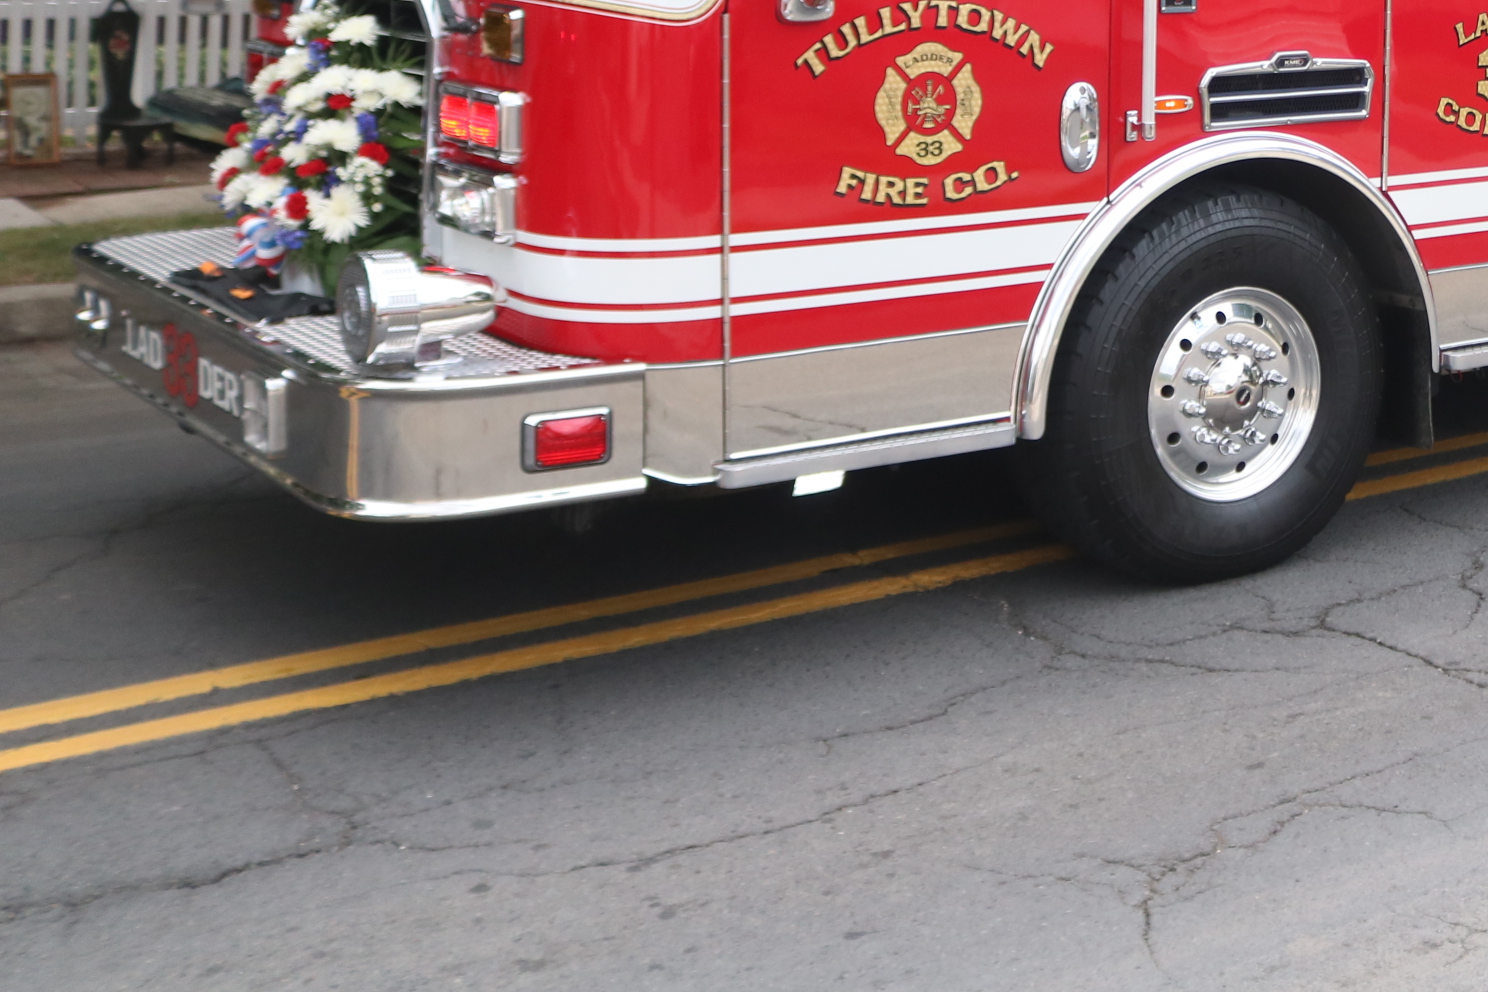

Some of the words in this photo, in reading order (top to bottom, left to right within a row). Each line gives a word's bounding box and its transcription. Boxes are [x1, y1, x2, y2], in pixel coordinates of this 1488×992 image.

[794, 0, 1055, 79] TULLYTOWN
[903, 51, 955, 69] LADDER
[915, 139, 944, 158] 33
[834, 165, 930, 207] FIRE
[943, 161, 1020, 203] CO.
[162, 322, 199, 408] 33
[198, 356, 241, 418] DER
